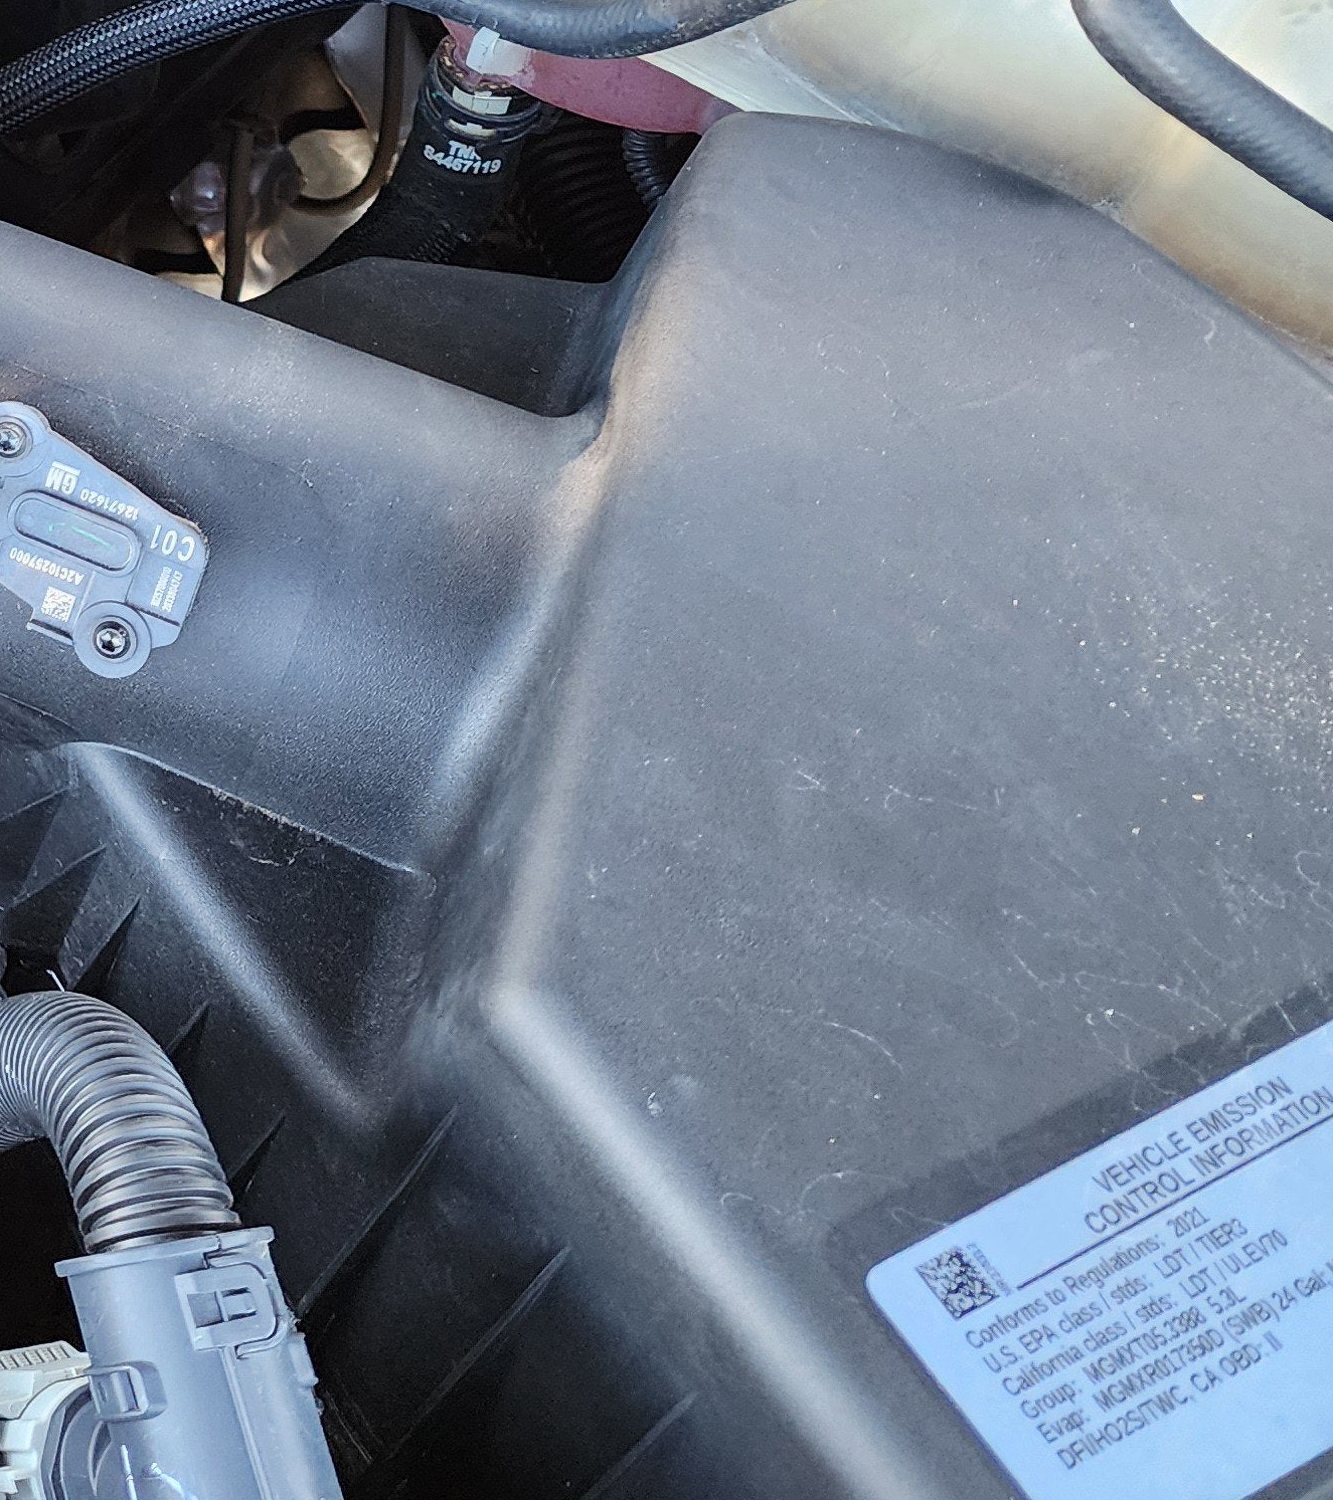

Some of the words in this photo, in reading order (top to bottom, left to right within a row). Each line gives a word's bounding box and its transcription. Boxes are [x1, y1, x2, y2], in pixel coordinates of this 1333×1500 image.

[44, 462, 81, 495] GM
[1084, 1168, 1195, 1234] CONTROL
[1189, 1086, 1333, 1177] INFORMATION
[1092, 1131, 1191, 1193] VEHICLE
[1185, 1076, 1293, 1143] EMISSION
[965, 1297, 1049, 1349] Conforms
[1044, 1288, 1067, 1306] to
[1062, 1234, 1165, 1296] Regulations:
[1166, 1206, 1211, 1238] 2021
[982, 1345, 1024, 1374] U.S.
[1019, 1323, 1060, 1354] EPA
[1058, 1300, 1103, 1333] class
[1154, 1249, 1191, 1278] LDT
[1195, 1218, 1248, 1254] TIER3
[1002, 1346, 1084, 1396] California
[1083, 1321, 1128, 1352] class
[1179, 1267, 1217, 1299] LDT
[1222, 1229, 1288, 1274] ULEV70
[1021, 1380, 1083, 1419] Group:
[1206, 1287, 1247, 1314] 5.3L
[1037, 1408, 1090, 1444] Evap:
[1222, 1298, 1280, 1343] (SWB)
[1272, 1286, 1297, 1311] 24
[1190, 1367, 1223, 1392] CA
